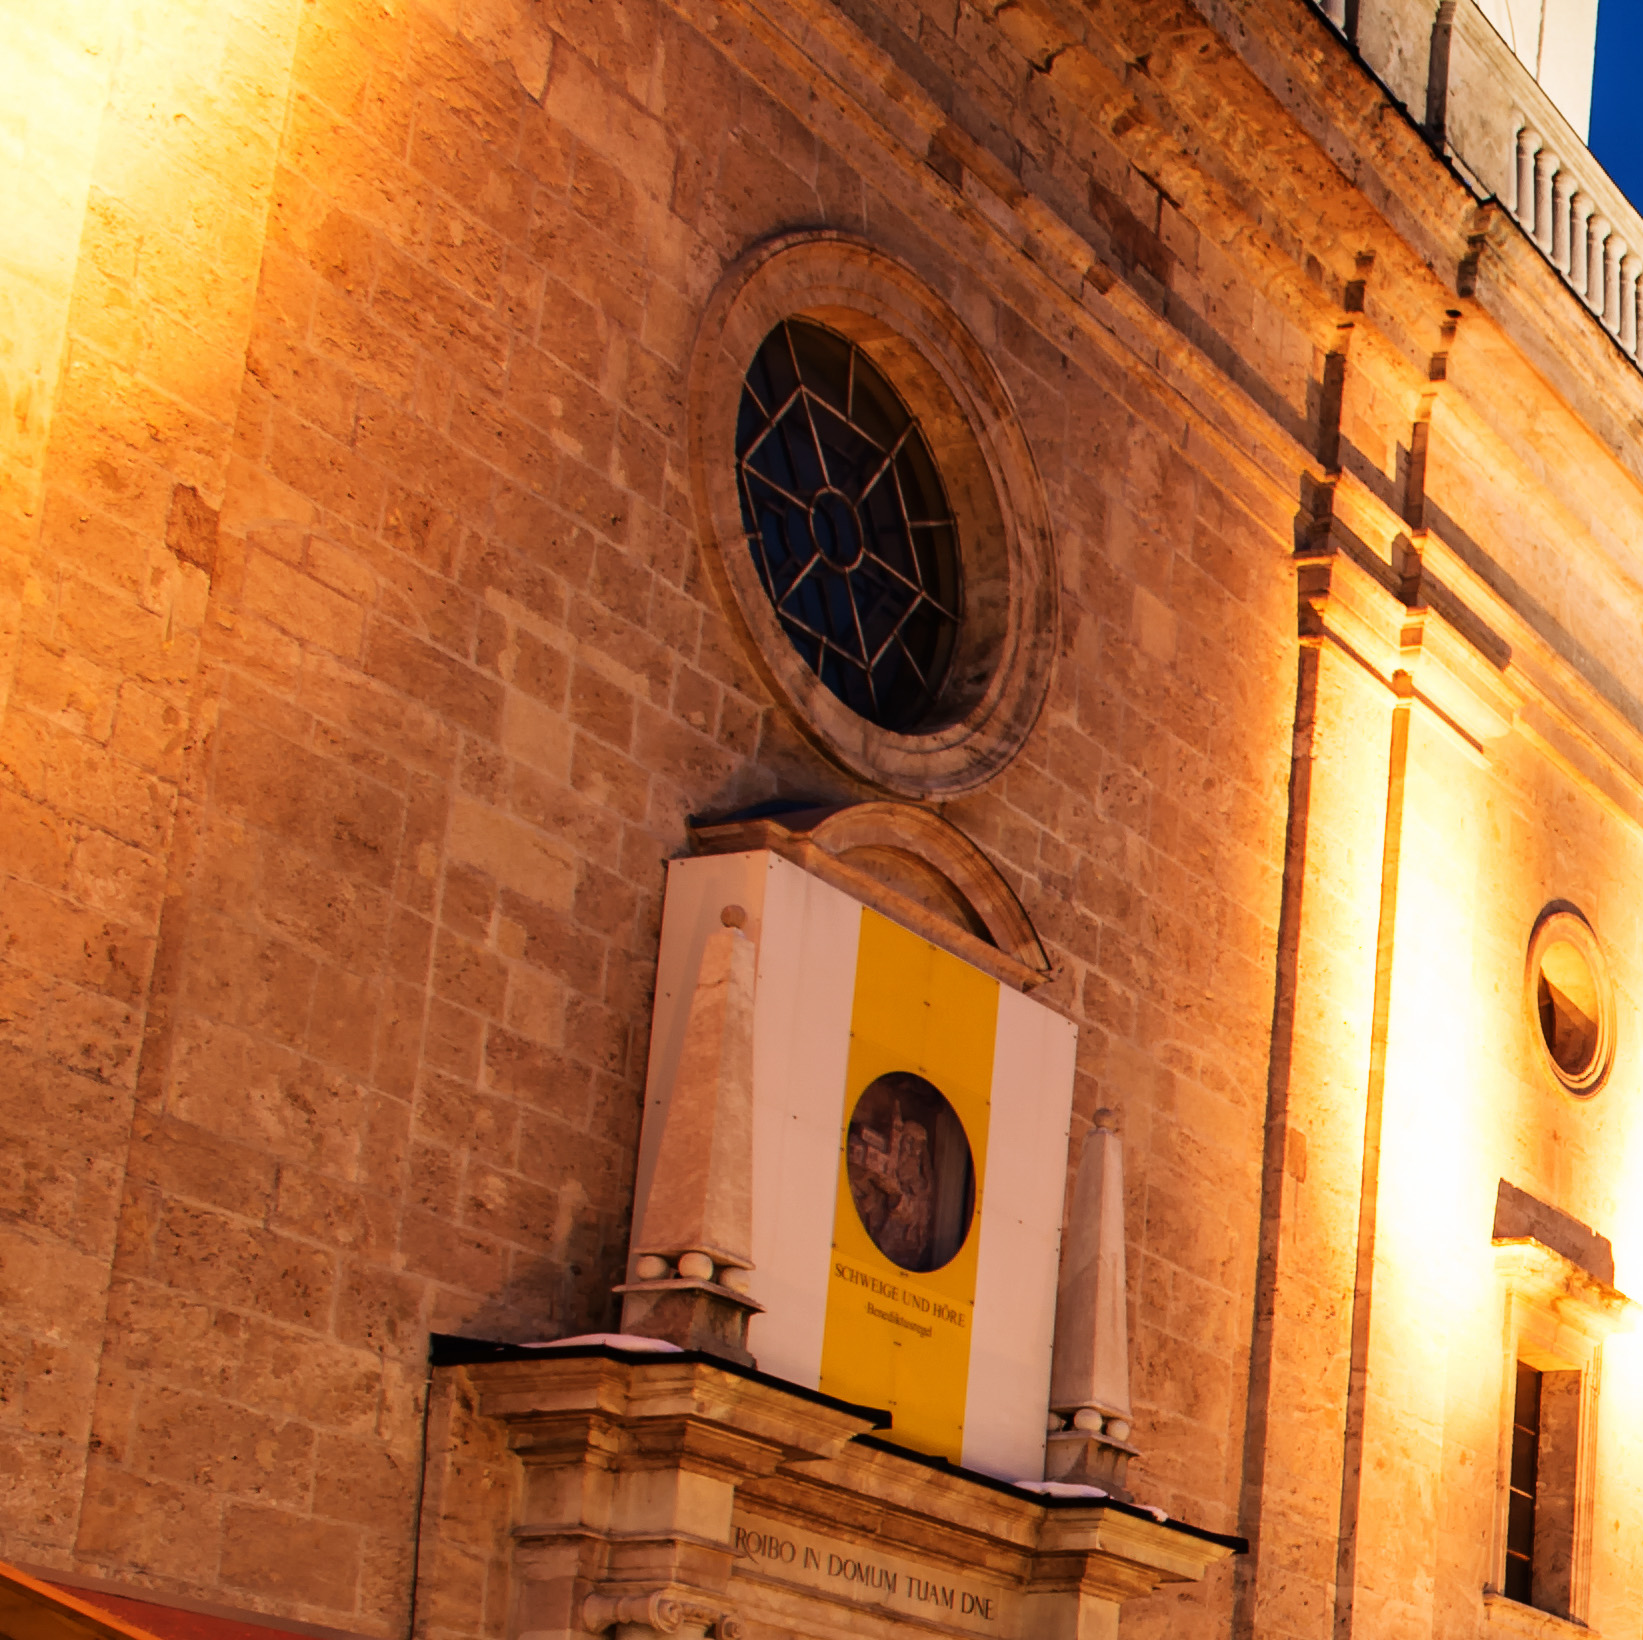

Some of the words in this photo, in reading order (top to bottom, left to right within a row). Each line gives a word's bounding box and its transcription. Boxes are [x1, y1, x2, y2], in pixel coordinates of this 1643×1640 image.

[834, 1262, 899, 1302] SCHWEIGE
[902, 1290, 930, 1313] UND
[933, 1303, 965, 1328] HÖRE
[734, 1526, 796, 1565] ROIBO
[803, 1546, 821, 1571] IN
[827, 1553, 898, 1594] DOMUM
[905, 1575, 954, 1610] TUAM
[961, 1591, 994, 1621] DNE
